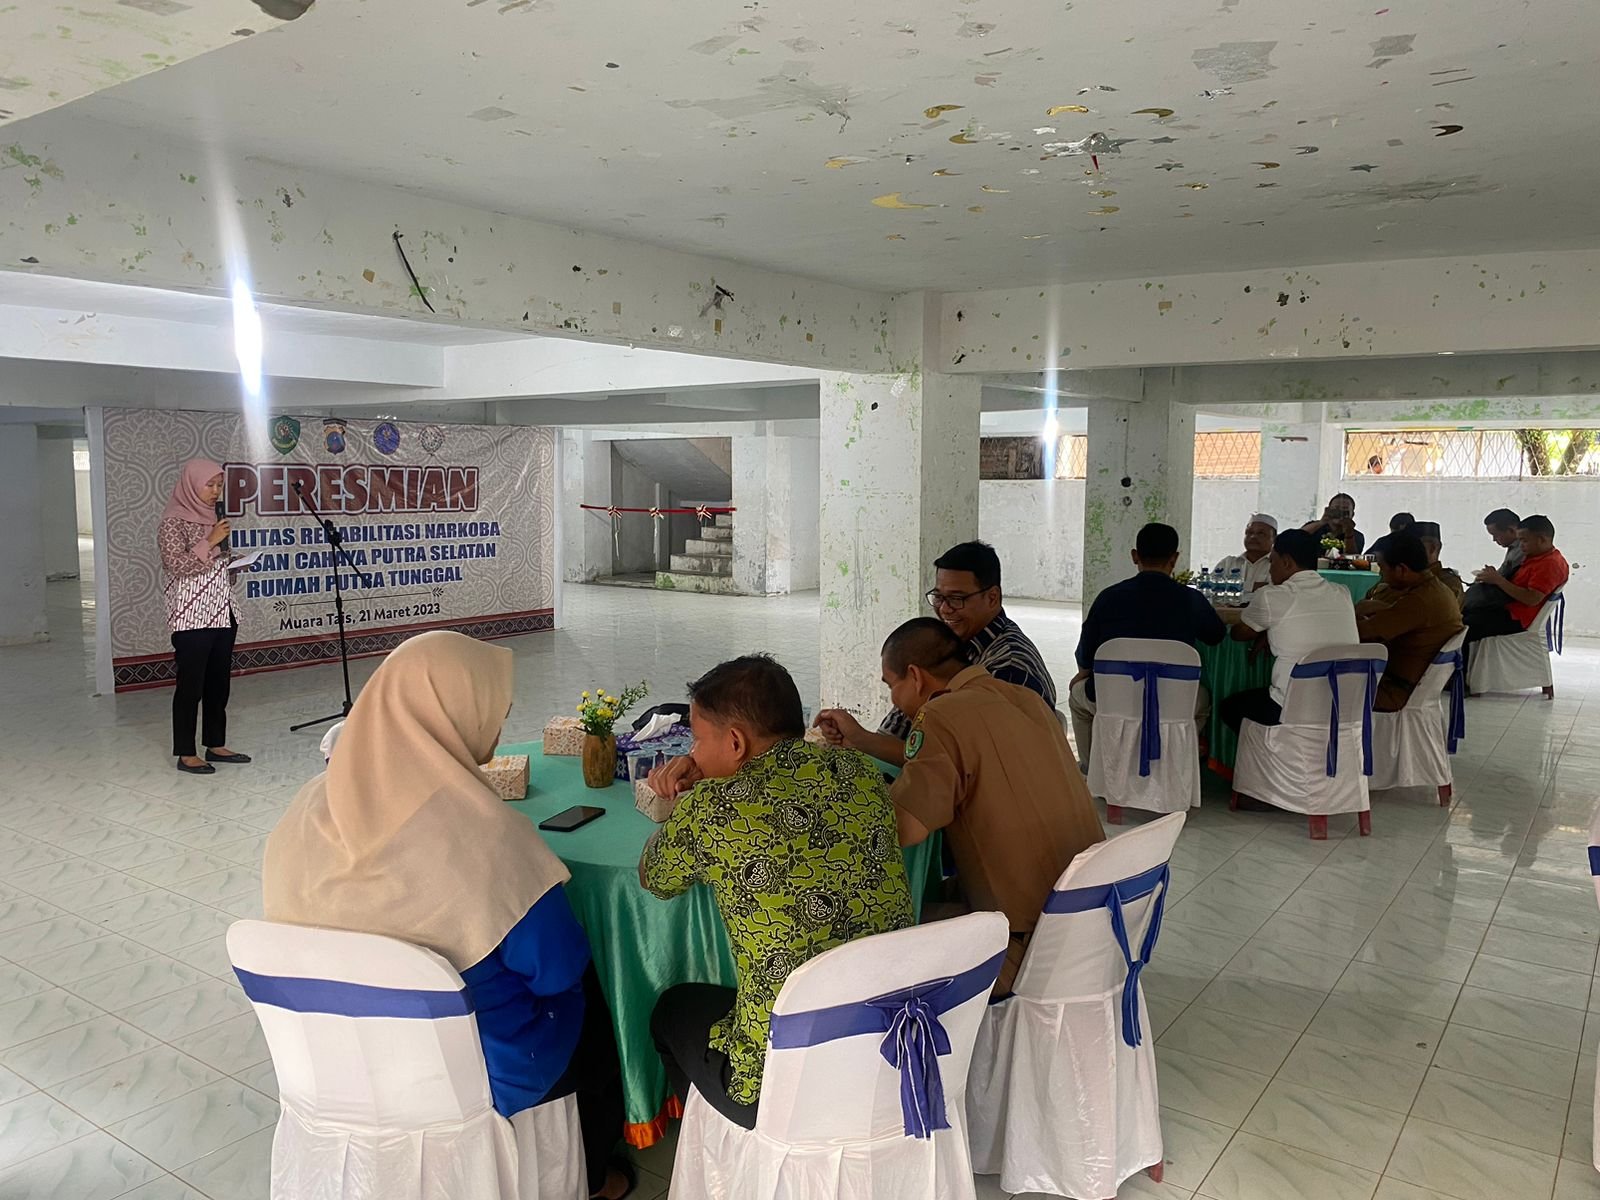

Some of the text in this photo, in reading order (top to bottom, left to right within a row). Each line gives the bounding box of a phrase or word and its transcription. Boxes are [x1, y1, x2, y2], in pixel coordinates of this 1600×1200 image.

[224, 463, 480, 516] PERESMIAN
[231, 527, 296, 548] ILITAS
[424, 521, 500, 539] NARKOBA
[295, 549, 368, 570] CAHAYA
[371, 546, 427, 565] PUTRA
[430, 543, 496, 561] SELATAN
[246, 566, 463, 599] RUMAH PUTRA TUNGGAL
[279, 616, 323, 631] Muara
[359, 609, 371, 622] 21
[374, 606, 411, 621] Maret
[413, 602, 441, 616] 2023
